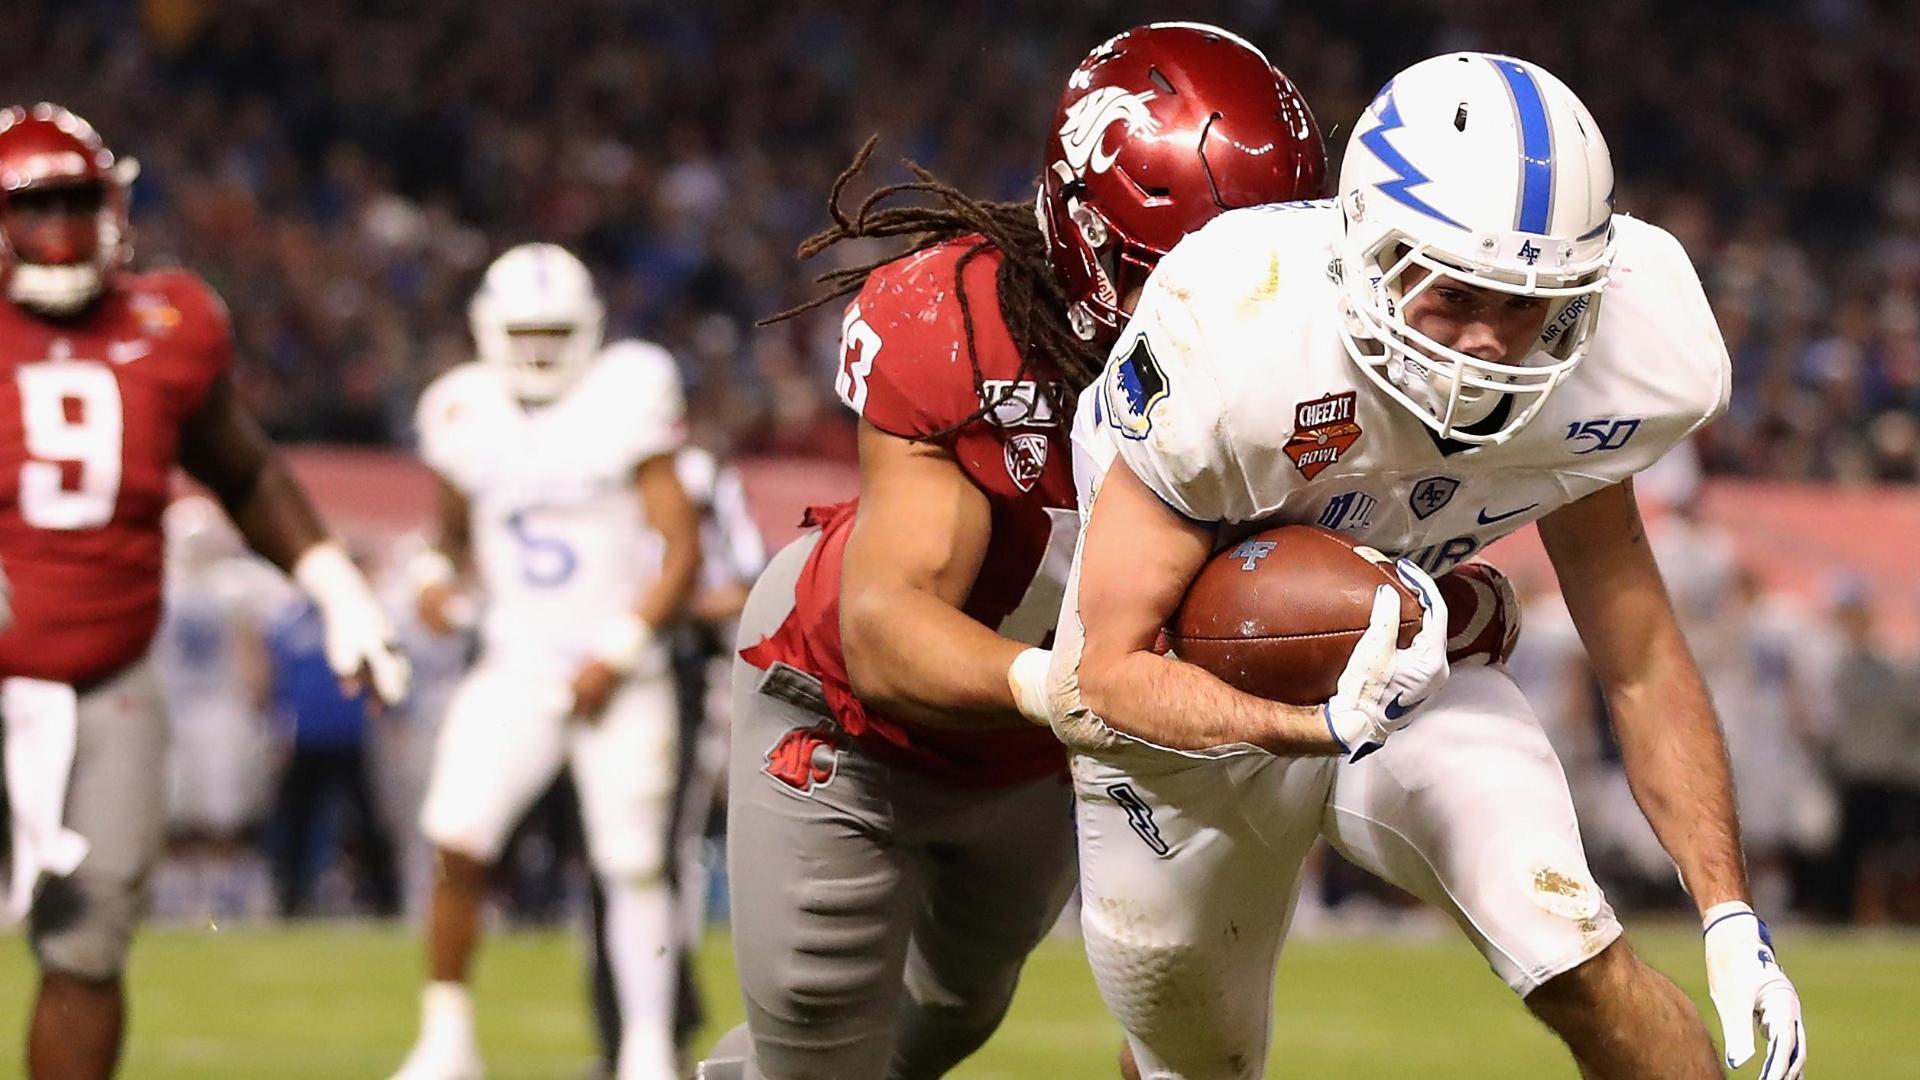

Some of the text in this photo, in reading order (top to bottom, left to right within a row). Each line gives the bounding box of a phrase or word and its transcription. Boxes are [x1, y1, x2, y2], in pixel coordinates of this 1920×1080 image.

[1517, 239, 1541, 266] AF
[1541, 293, 1592, 344] AIR FORC
[835, 303, 883, 417] 13
[16, 360, 124, 530] 9
[1565, 419, 1641, 454] 150
[1298, 447, 1338, 468] BOWL
[1417, 482, 1446, 508] AF
[505, 504, 577, 590] 5
[1228, 540, 1277, 571] AF
